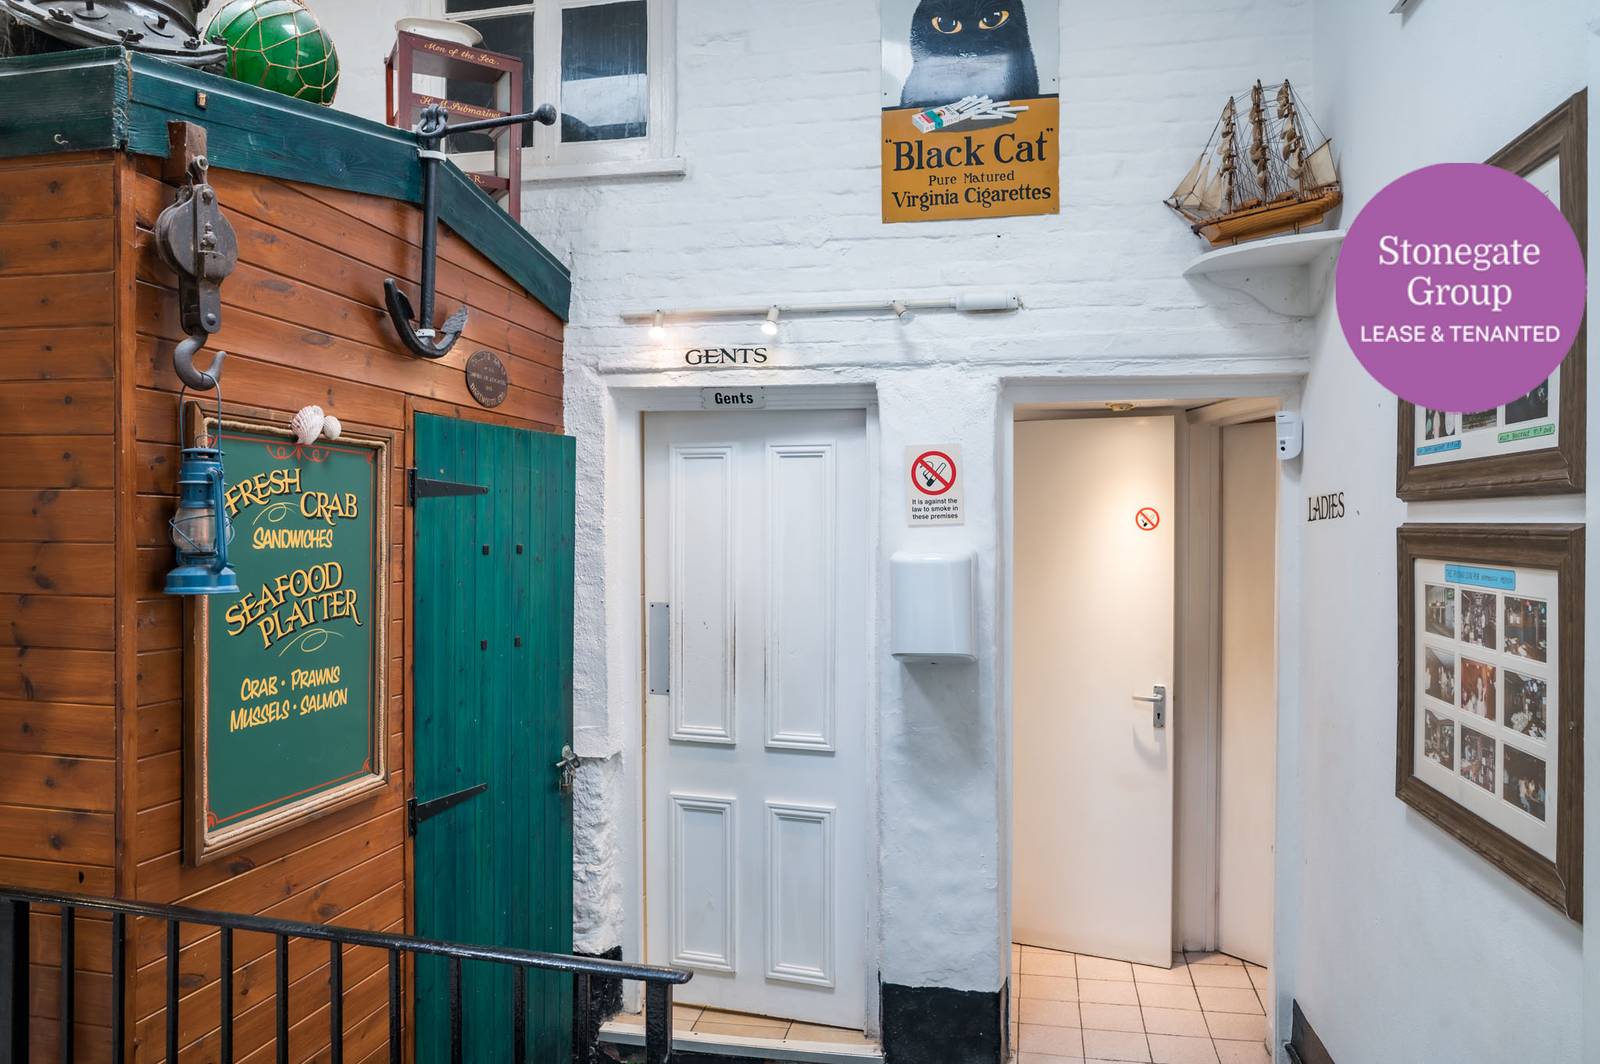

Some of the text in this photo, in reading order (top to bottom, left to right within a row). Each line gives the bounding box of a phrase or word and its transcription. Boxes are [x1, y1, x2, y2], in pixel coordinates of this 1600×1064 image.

[448, 48, 459, 57] of
[460, 51, 475, 60] the
[928, 170, 1015, 187] Pure Matured
[892, 186, 1051, 212] Virginia Cigarettes
[685, 347, 767, 365] GENTS
[714, 392, 754, 405] Gents
[224, 468, 358, 526] FRESH CRAB
[924, 498, 947, 506] against
[1307, 492, 1345, 522] LADIES
[252, 527, 333, 549] SANDWICHES
[225, 561, 343, 637] SEAFOOD
[257, 589, 362, 649] PLATTER
[241, 666, 340, 701] CRAB PRAWNS
[230, 688, 348, 732] MUSSELS SALMON
